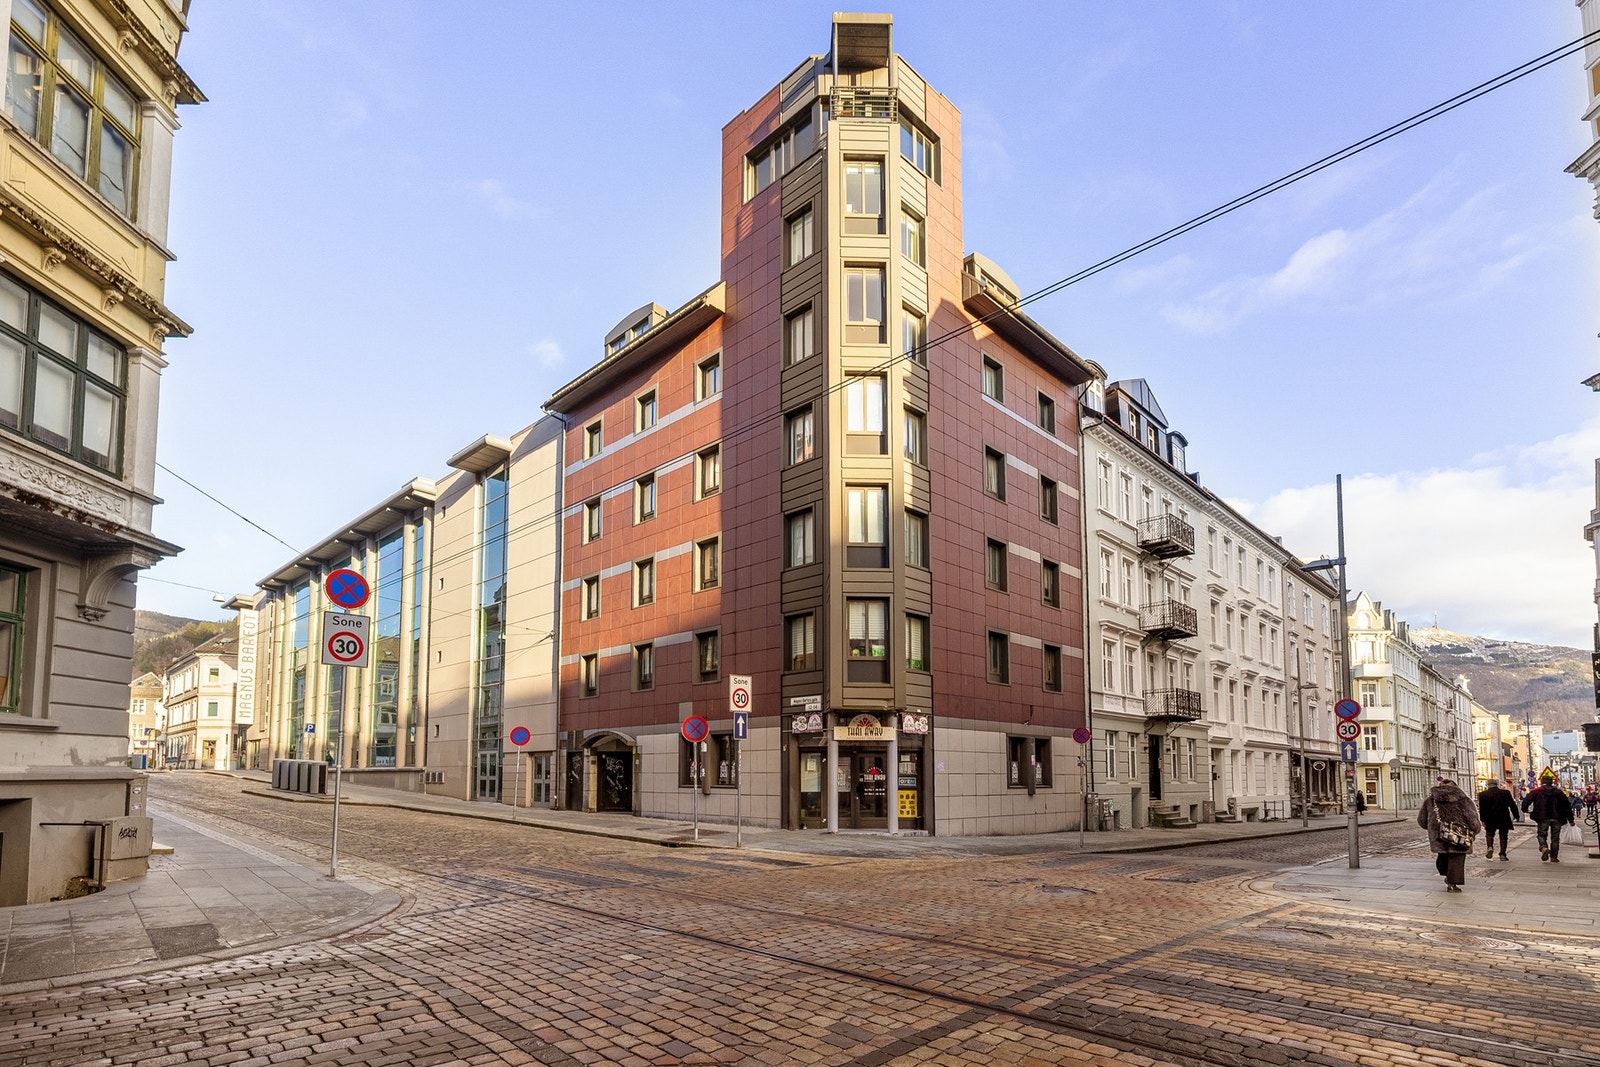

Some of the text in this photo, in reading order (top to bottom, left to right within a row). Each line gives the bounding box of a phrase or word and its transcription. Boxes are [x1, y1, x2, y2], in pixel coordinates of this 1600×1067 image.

[332, 616, 363, 628] Sone
[335, 639, 358, 655] 30
[239, 614, 256, 718] MAGNUS BARFOT
[733, 677, 748, 685] Sone
[735, 693, 746, 703] 30
[847, 727, 884, 736] THAI AWAY
[1341, 725, 1356, 735] 30
